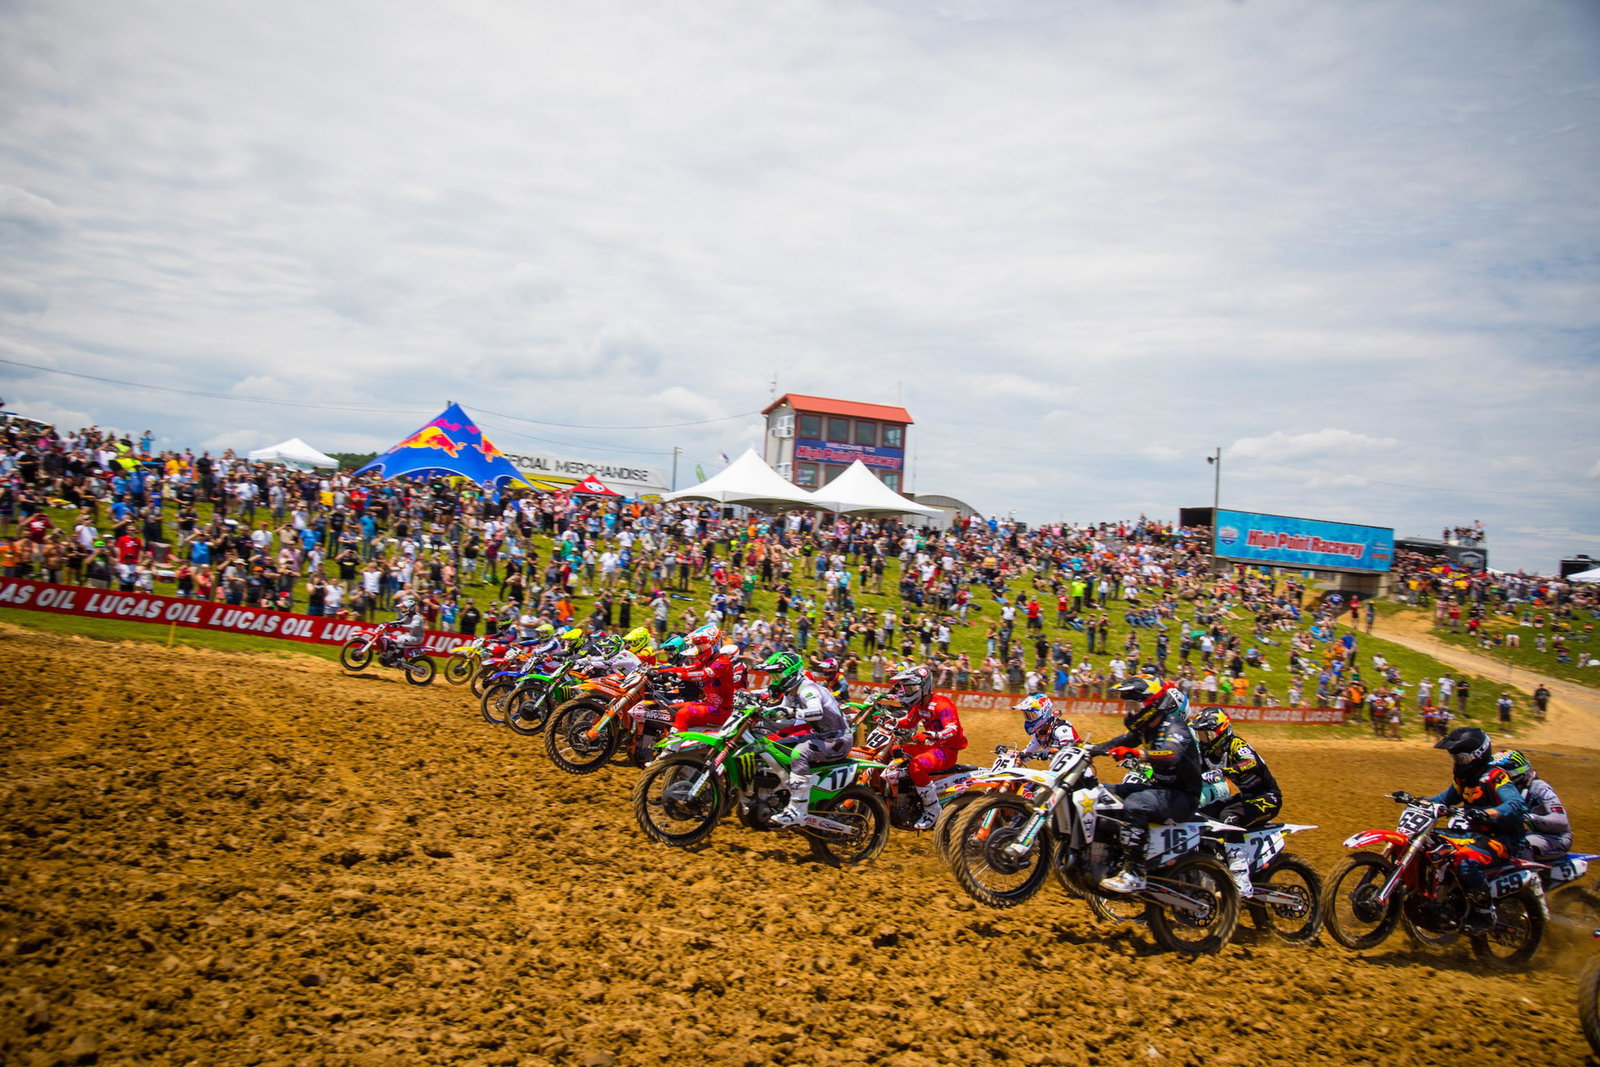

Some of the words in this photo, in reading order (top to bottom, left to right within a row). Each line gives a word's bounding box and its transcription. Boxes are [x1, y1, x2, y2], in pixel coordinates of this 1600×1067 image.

[796, 445, 823, 460] High
[825, 448, 853, 462] Point
[505, 453, 550, 471] FICIAL
[555, 460, 648, 482] MERCHANDISE
[1246, 529, 1277, 550] High
[1277, 532, 1310, 552] Point
[1311, 536, 1366, 559] Raceway
[0, 582, 36, 604] AS
[36, 588, 77, 610] OIL
[84, 593, 165, 619] LUCAS
[165, 602, 203, 624] OIL
[208, 608, 281, 633] LUCAS
[281, 617, 315, 638] OIL
[956, 694, 993, 709] LUCAS
[866, 731, 889, 750] 19
[828, 768, 848, 791] 17
[1399, 811, 1430, 833] 69
[1160, 828, 1188, 856] 16
[1250, 835, 1276, 861] 21
[1496, 873, 1523, 898] 69
